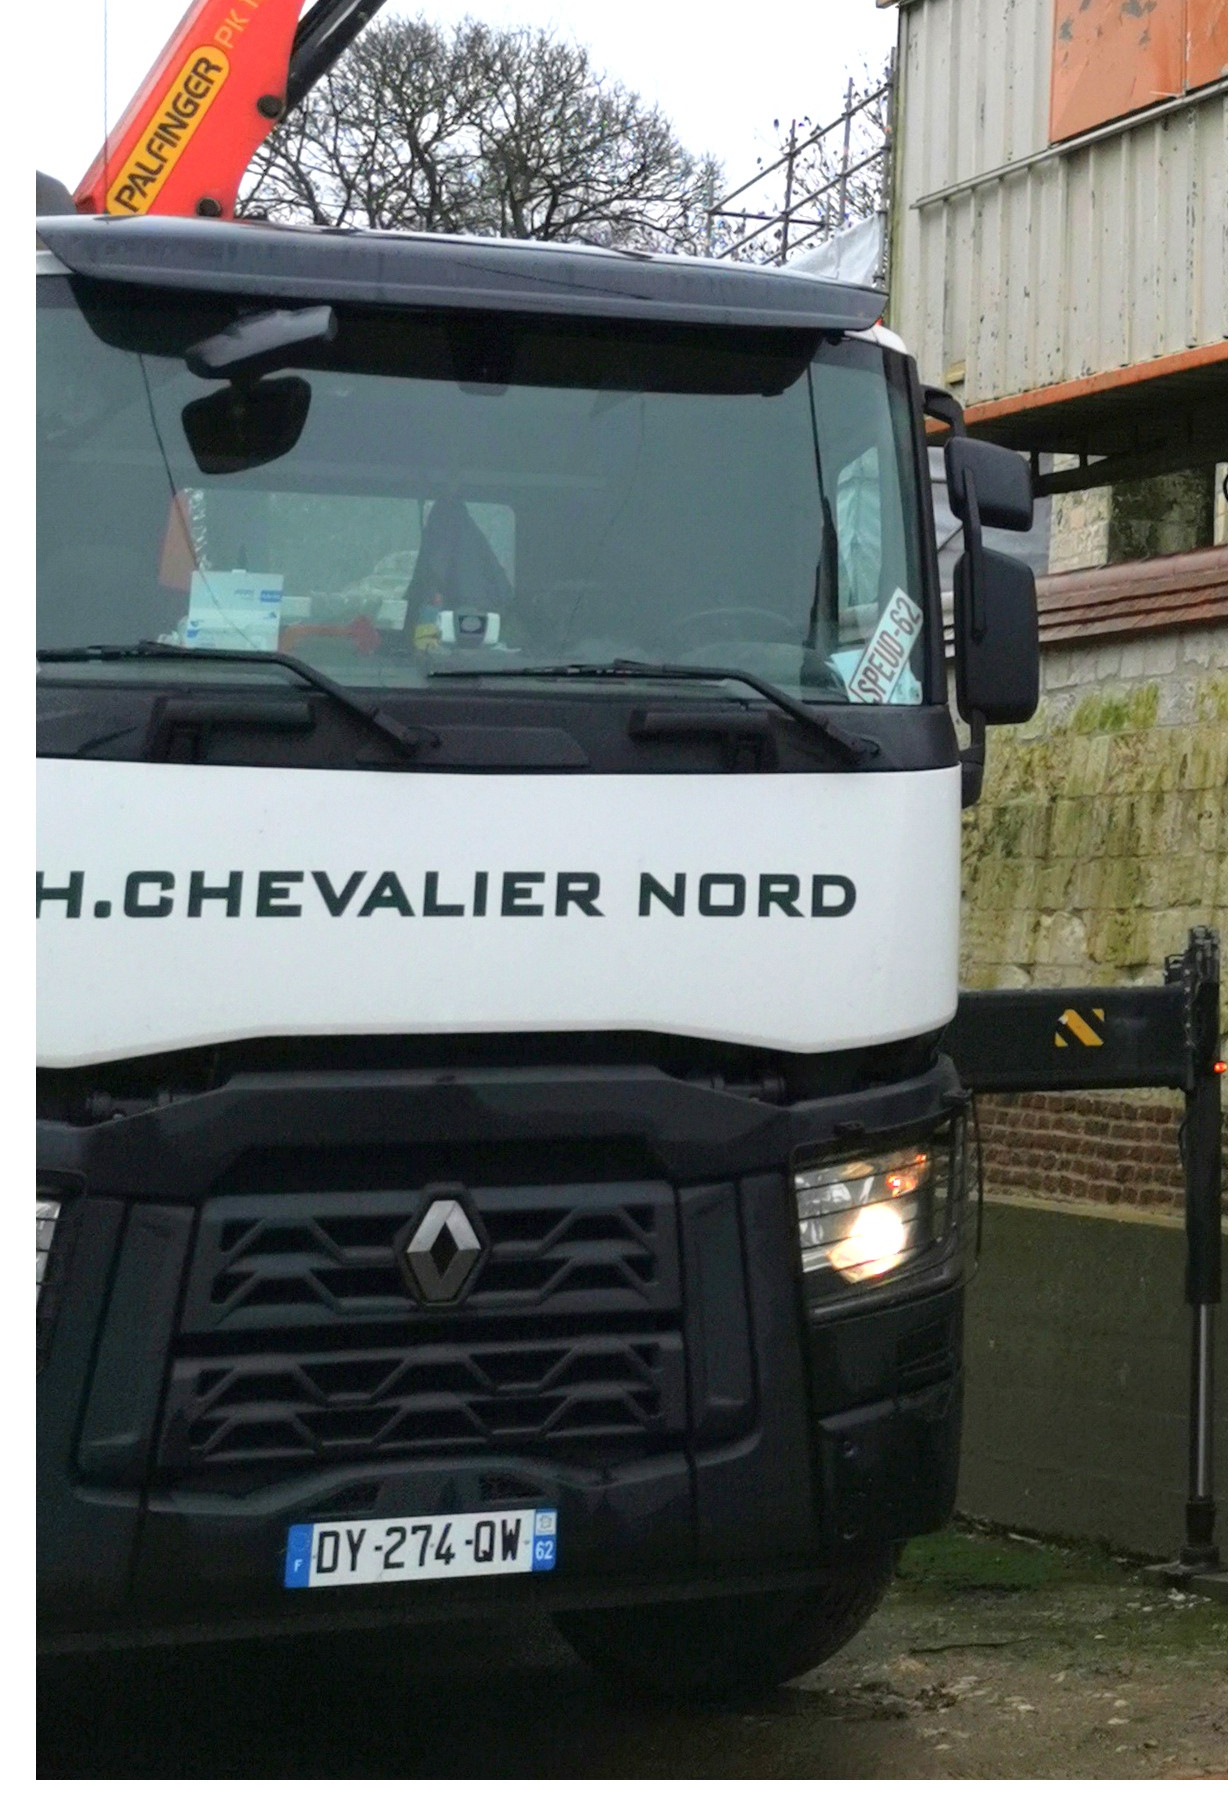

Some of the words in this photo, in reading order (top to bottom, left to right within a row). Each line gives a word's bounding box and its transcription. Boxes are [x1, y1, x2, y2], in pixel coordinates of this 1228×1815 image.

[213, 8, 249, 49] PK
[114, 56, 223, 213] PALFINGER
[857, 596, 921, 704] SPEUD-62
[638, 871, 857, 919] NORD
[293, 1558, 303, 1573] F
[315, 1518, 522, 1574] DY-274-QW
[534, 1540, 554, 1561] 62
